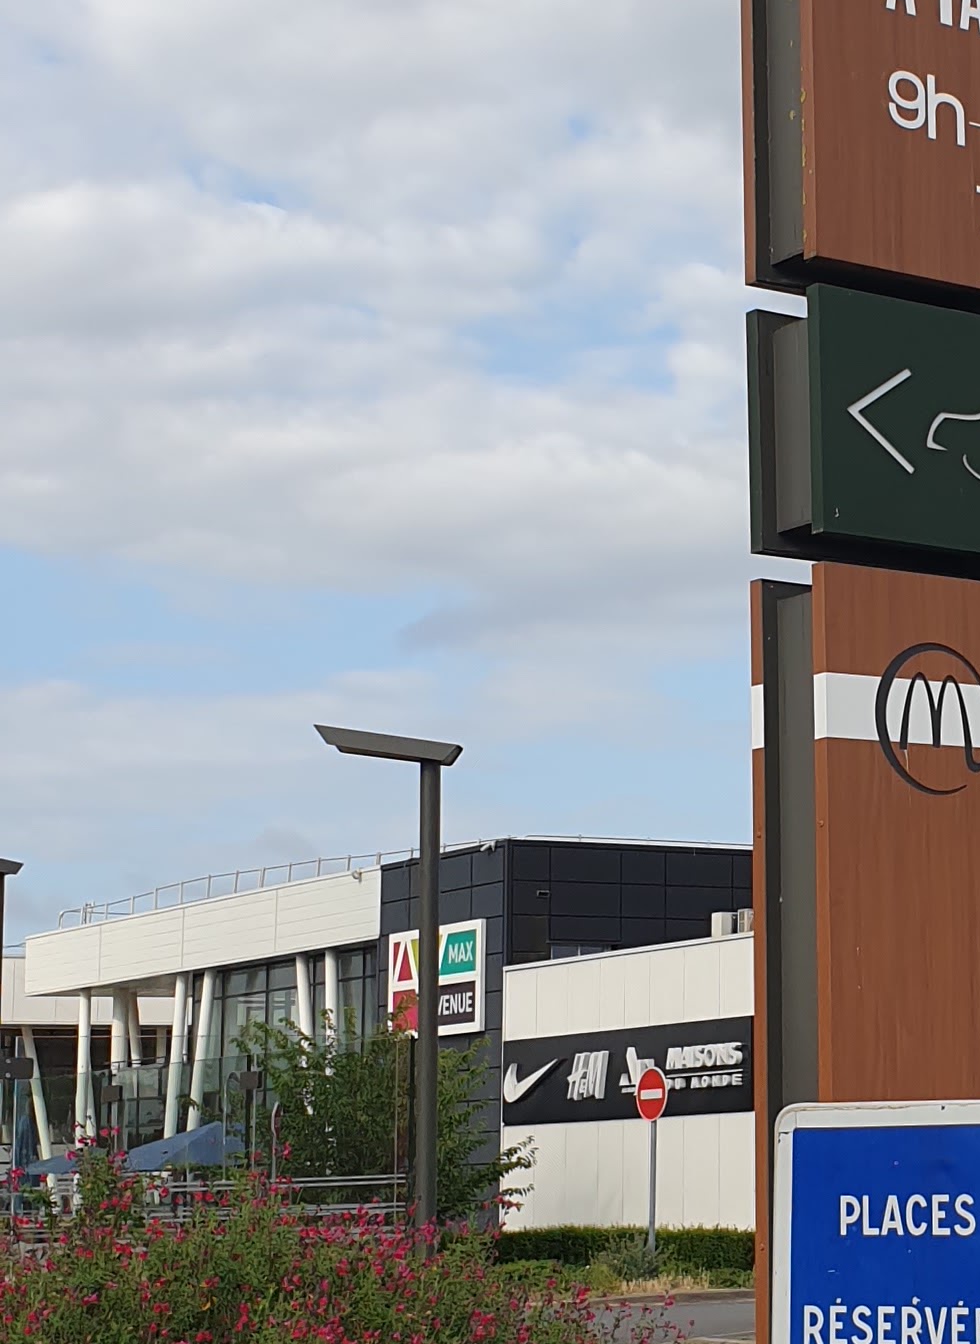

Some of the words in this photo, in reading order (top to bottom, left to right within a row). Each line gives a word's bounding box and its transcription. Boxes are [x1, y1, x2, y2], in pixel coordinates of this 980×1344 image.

[448, 940, 474, 965] MAX
[438, 991, 473, 1016] VENUE
[665, 1042, 743, 1070] MAISONS
[567, 1050, 610, 1101] H&M
[839, 1194, 977, 1237] PLACES
